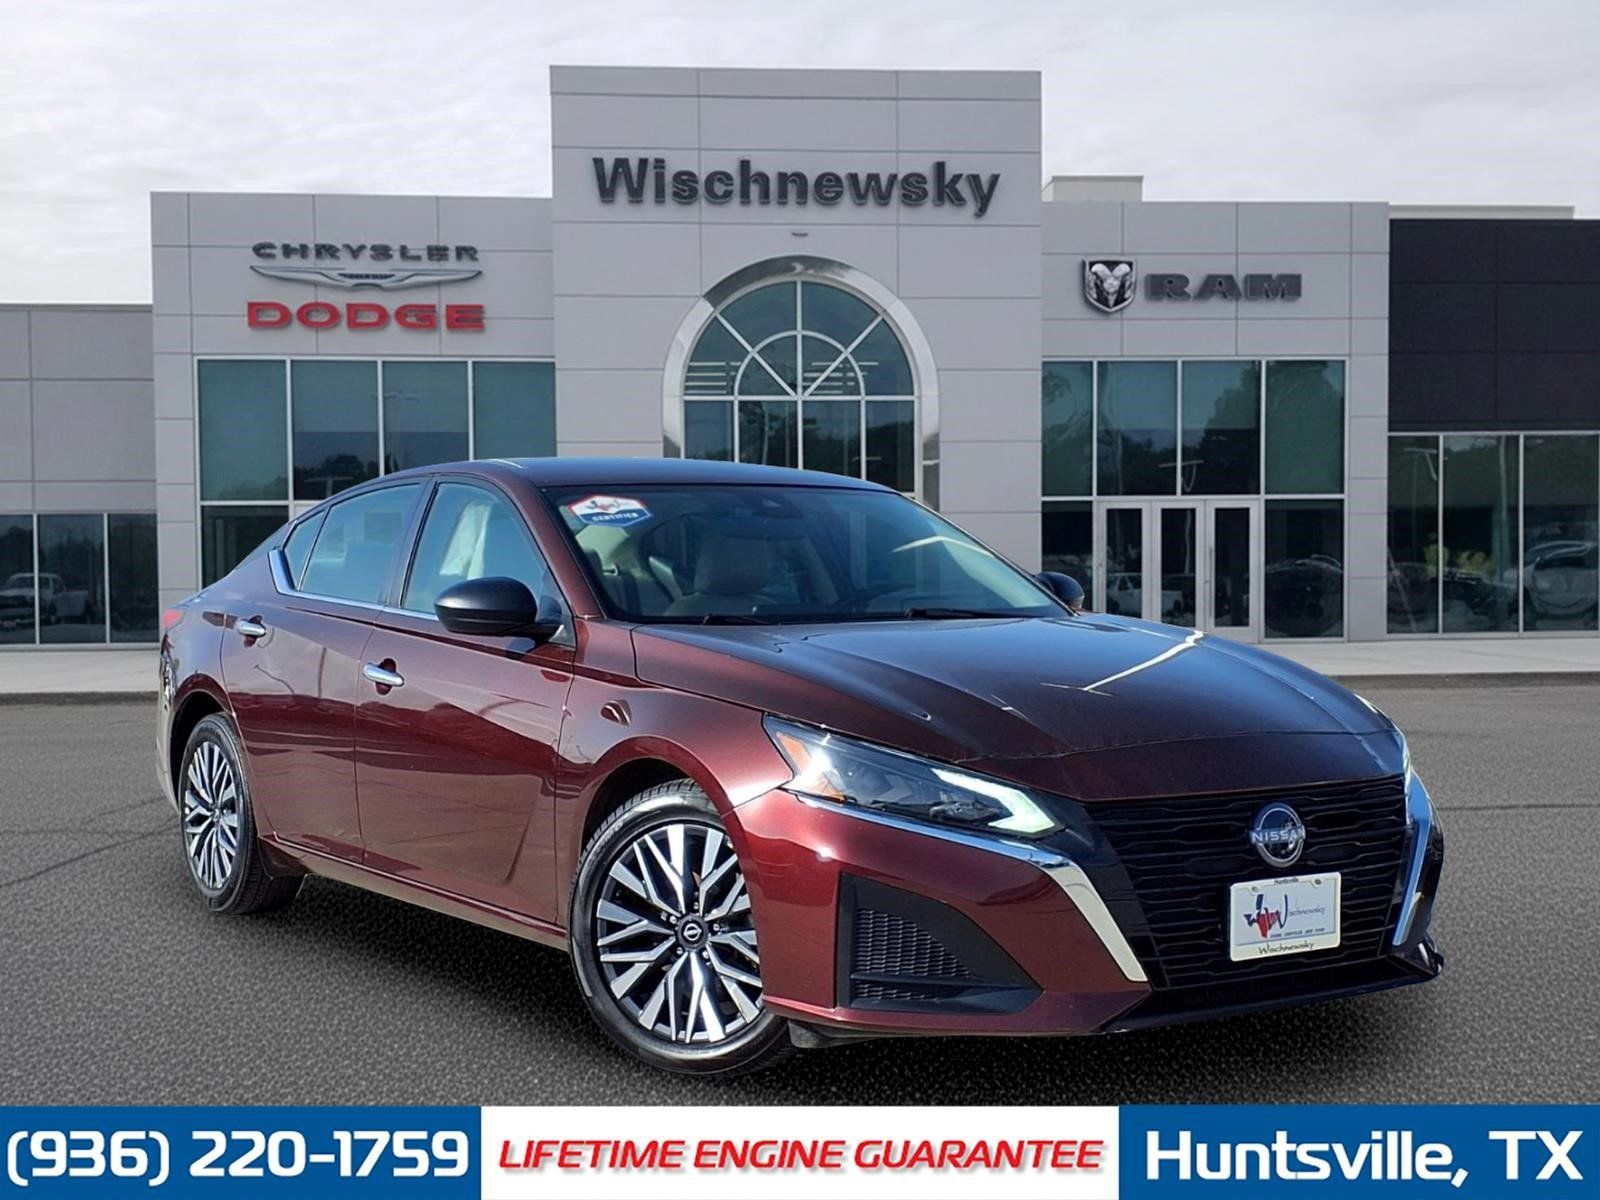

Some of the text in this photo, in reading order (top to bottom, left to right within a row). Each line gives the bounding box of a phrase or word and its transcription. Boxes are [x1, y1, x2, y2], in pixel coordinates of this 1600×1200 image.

[592, 157, 1001, 218] Wischnewsky
[251, 241, 479, 262] CHRYSLER
[1144, 273, 1302, 301] RAM
[247, 301, 485, 331] DODGE
[1251, 826, 1306, 844] NISSAN
